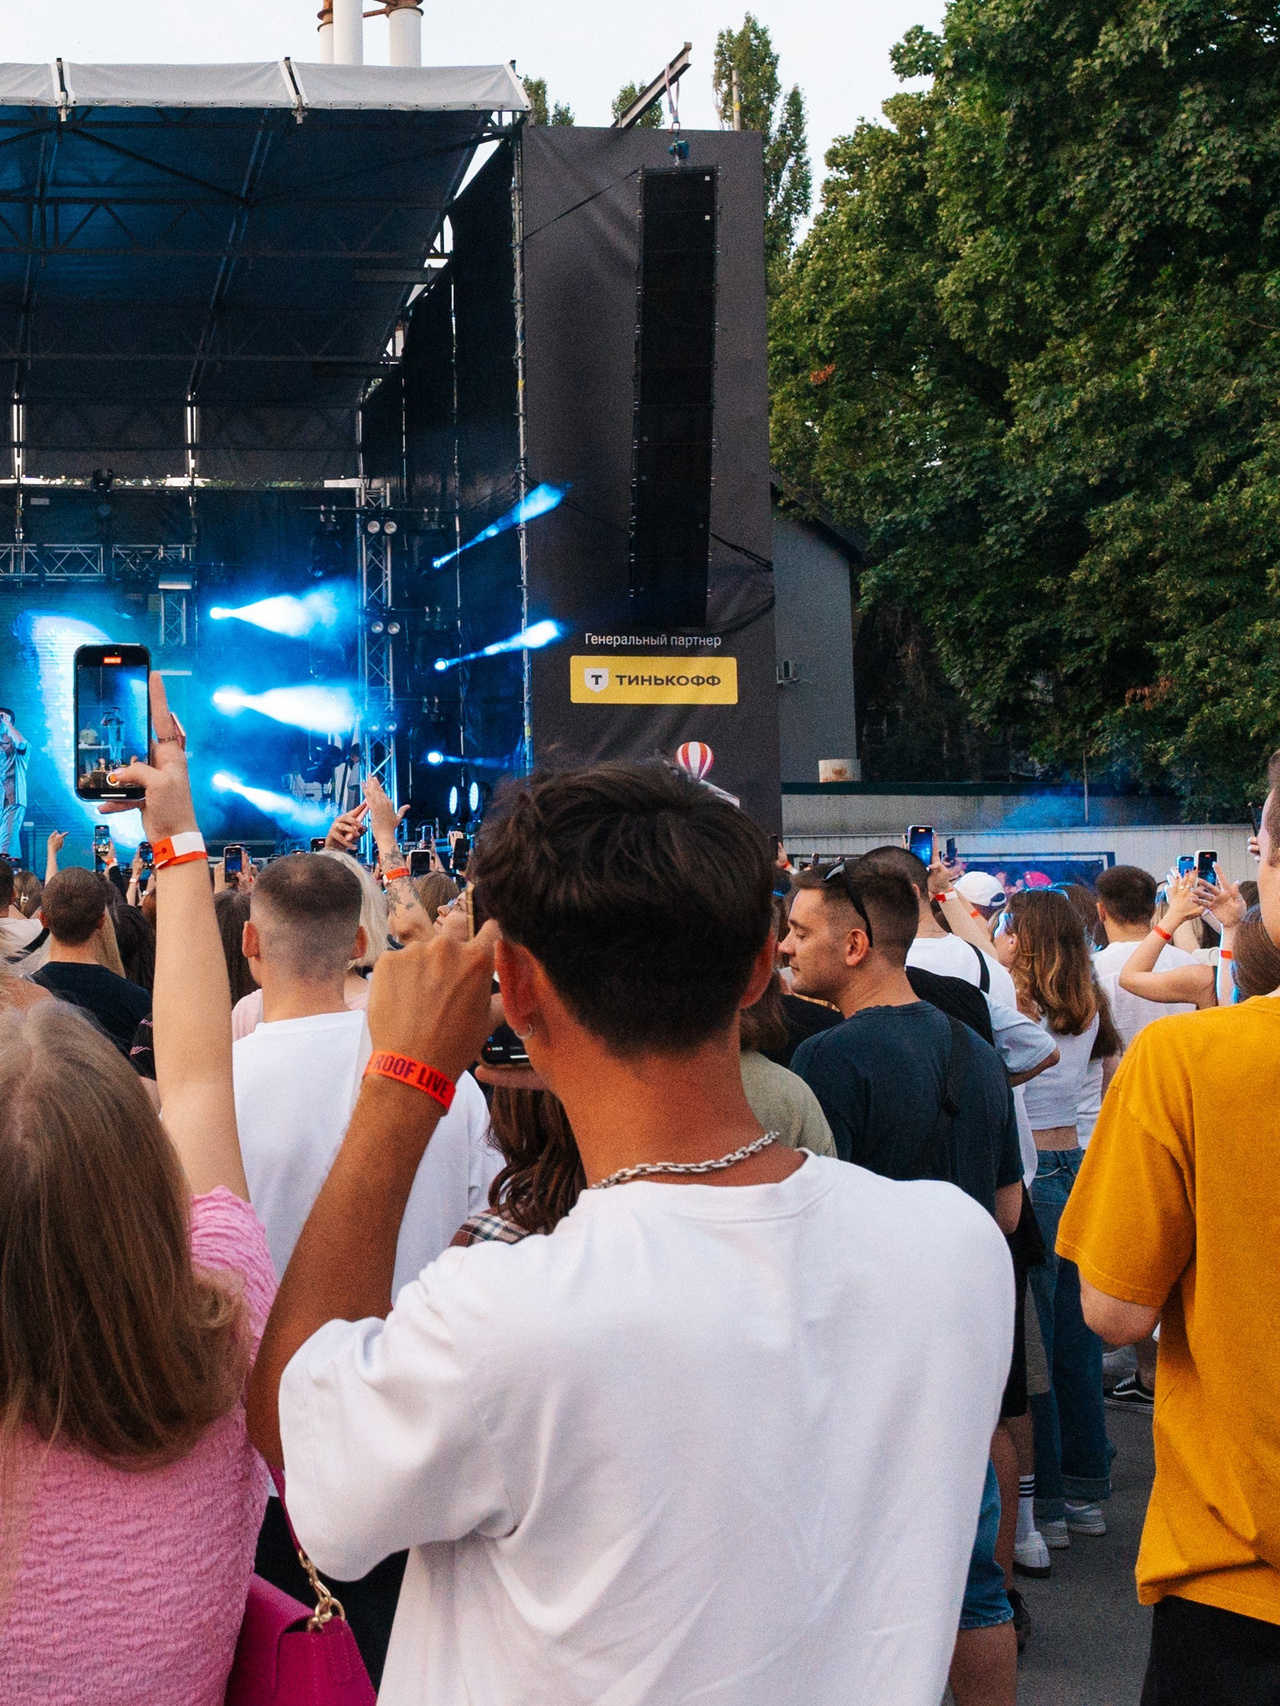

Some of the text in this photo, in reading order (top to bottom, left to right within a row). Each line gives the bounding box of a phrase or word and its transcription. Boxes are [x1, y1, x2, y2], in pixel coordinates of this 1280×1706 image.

[585, 632, 722, 648] Генеральный партнер
[615, 674, 721, 686] ТИНЬКОФФ
[374, 1055, 449, 1099] ROOF LIVE
